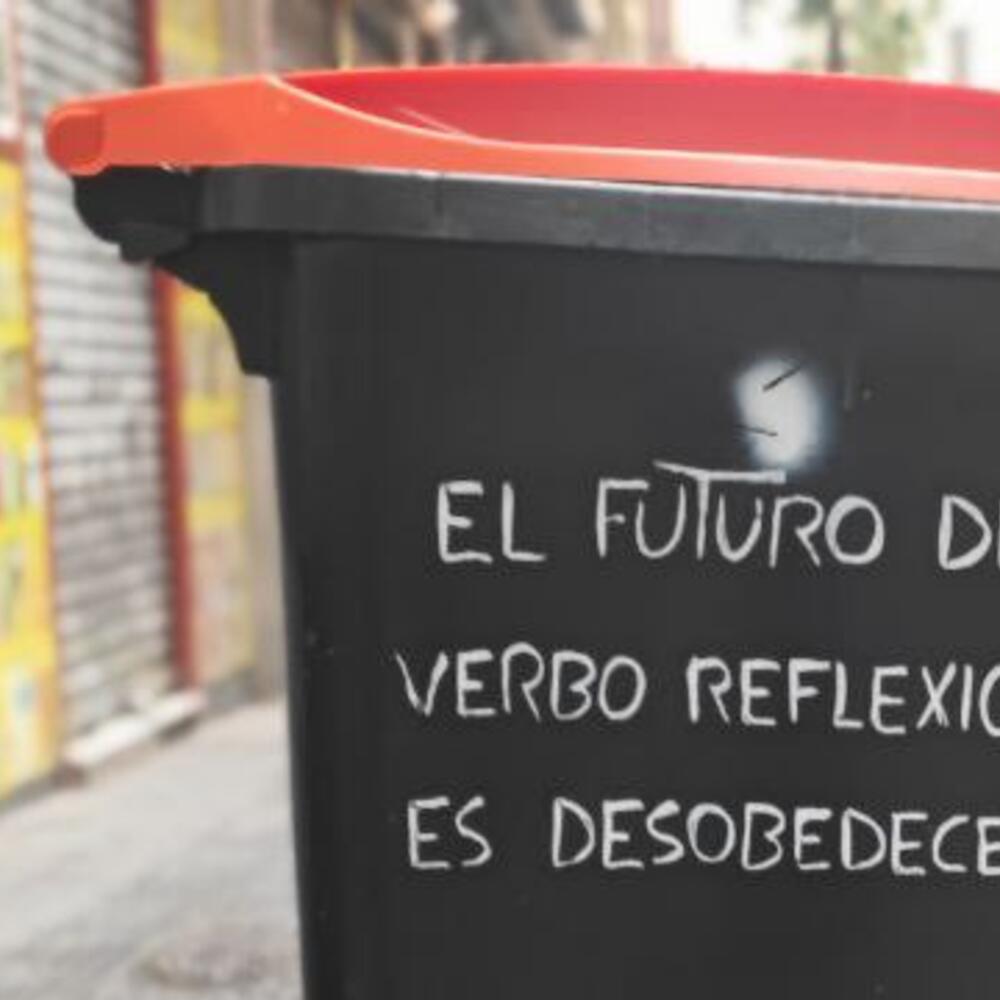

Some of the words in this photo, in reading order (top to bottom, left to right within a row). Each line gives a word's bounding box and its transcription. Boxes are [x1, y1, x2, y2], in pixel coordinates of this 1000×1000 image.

[438, 481, 545, 564] EL
[596, 462, 885, 568] FUTURO
[396, 642, 647, 721] VERBO
[408, 796, 492, 870] ES
